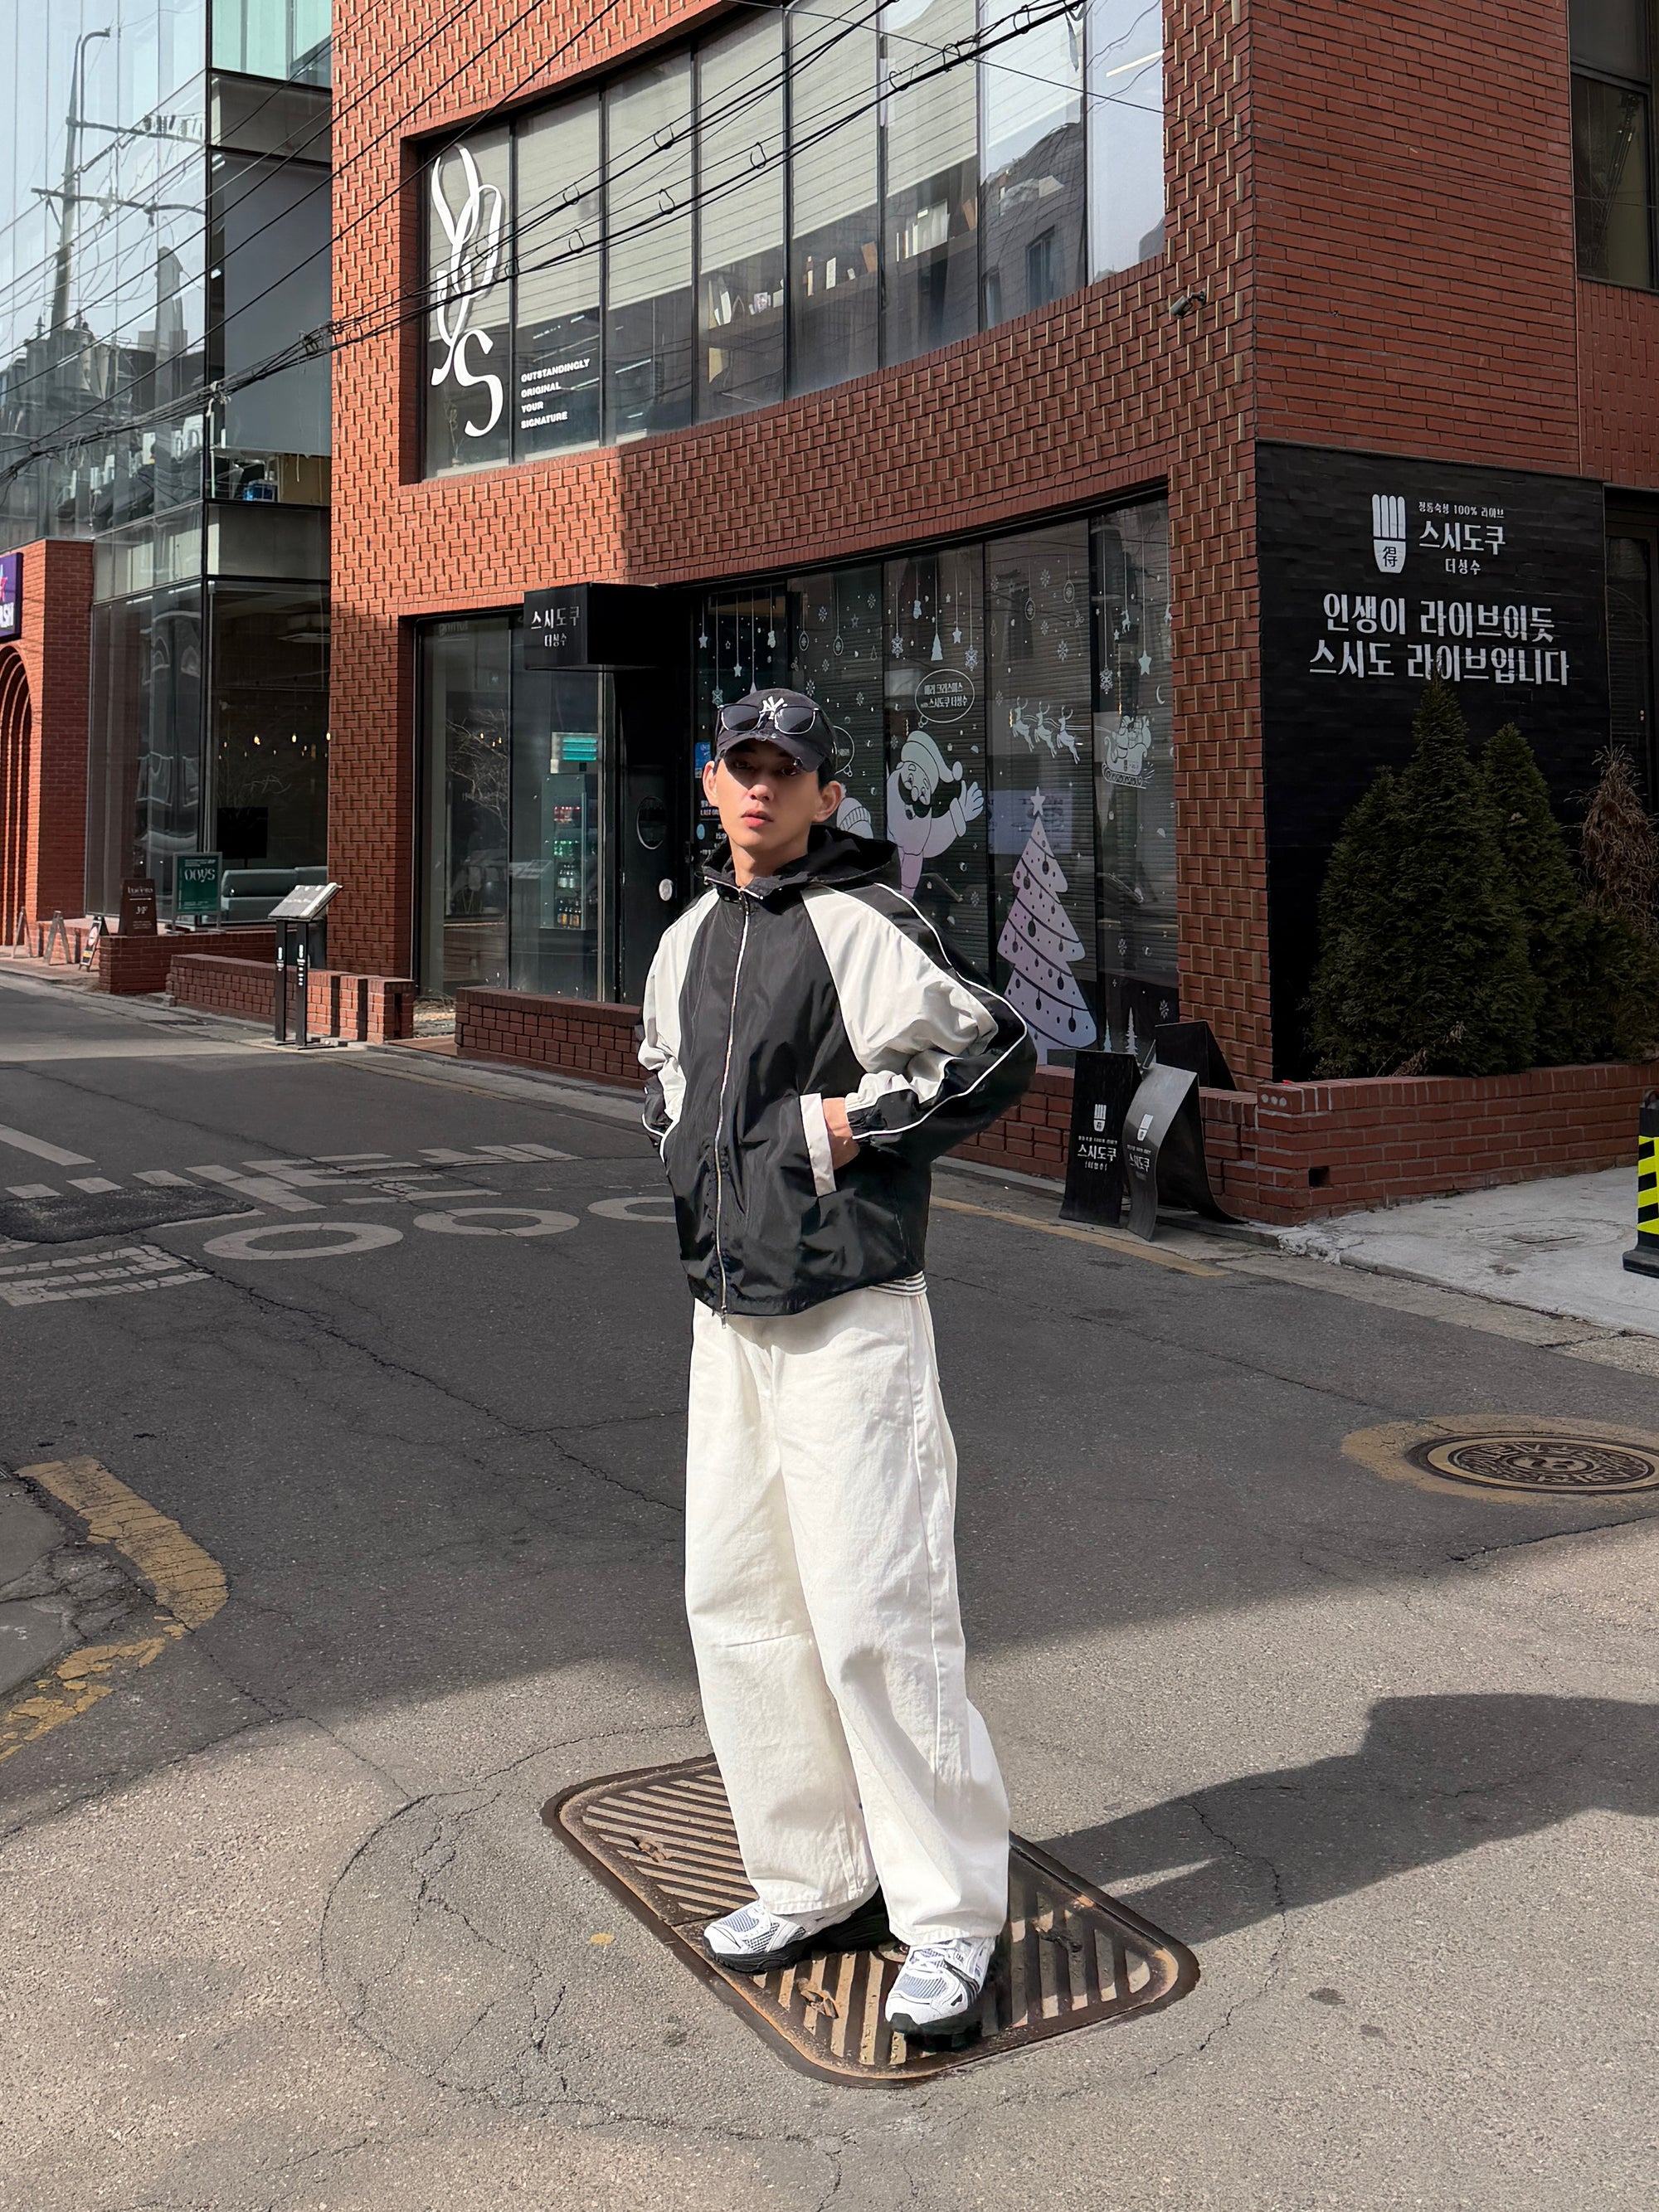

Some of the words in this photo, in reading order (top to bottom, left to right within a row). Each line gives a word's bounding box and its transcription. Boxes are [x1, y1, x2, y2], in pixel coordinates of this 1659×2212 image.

[521, 358, 590, 382] OUTSTANDINGLY
[521, 382, 562, 398] ORIGINAL
[521, 401, 544, 413] YOUR
[521, 411, 567, 430] SIGNATURE
[1453, 504, 1477, 516] 100%
[1481, 507, 1505, 518] 라이브
[1419, 520, 1506, 556] 스시도쿠
[1445, 558, 1481, 575] 더성수
[531, 606, 580, 630] 스시도쿠
[1323, 593, 1406, 634] 인생이
[1420, 600, 1554, 643] 라이브이듯
[1309, 639, 1394, 678] 스시도
[1407, 644, 1569, 685] 라이브입니다
[928, 697, 950, 708] 스시도쿠
[1077, 1144, 1117, 1162] 스시도쿠
